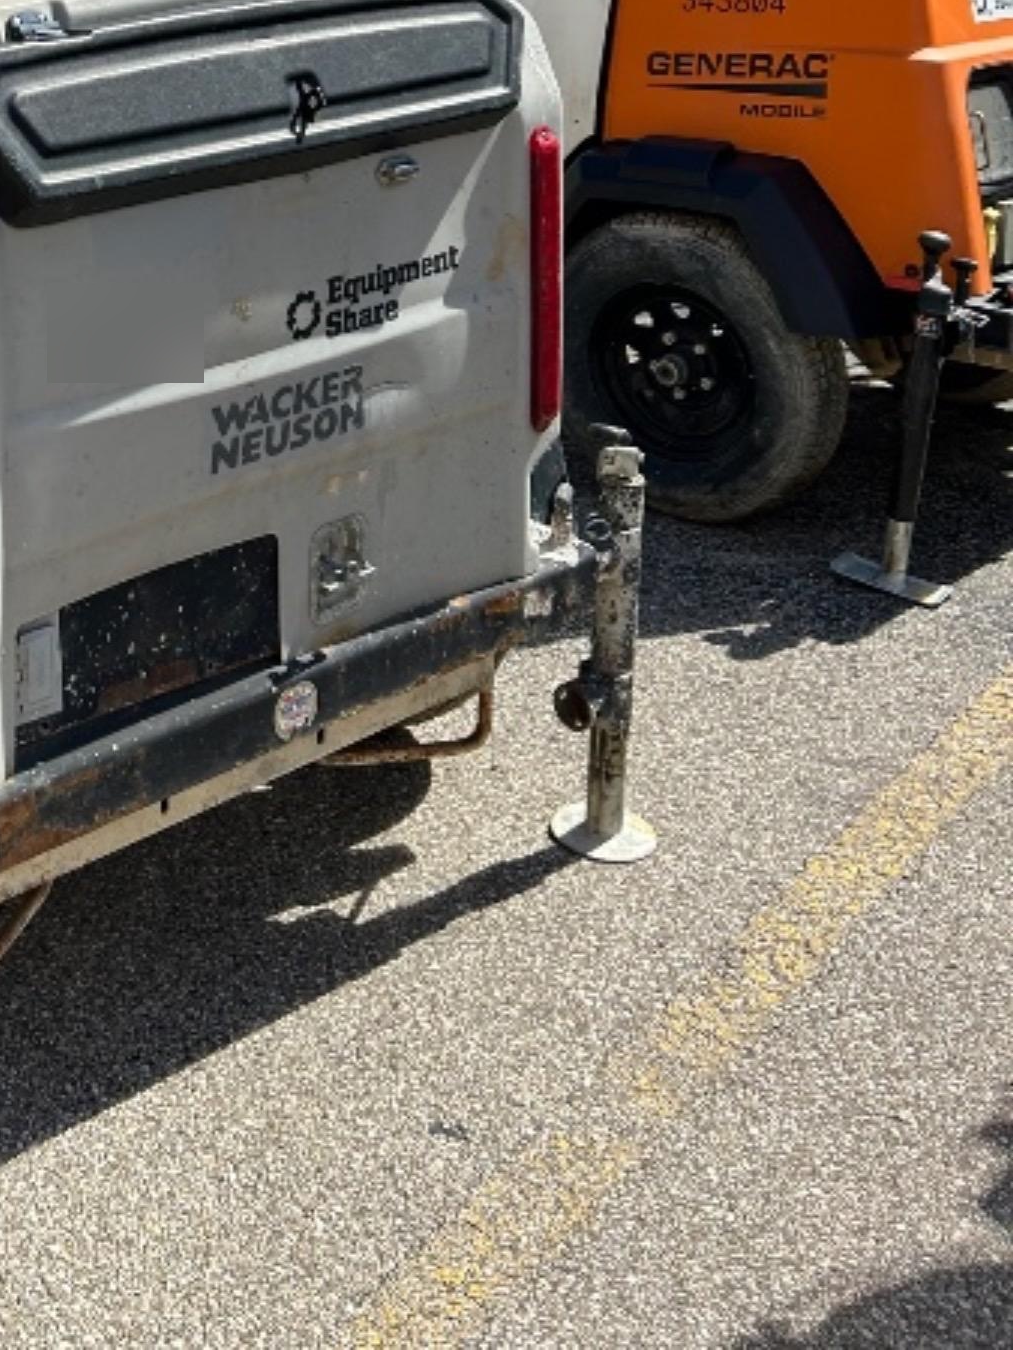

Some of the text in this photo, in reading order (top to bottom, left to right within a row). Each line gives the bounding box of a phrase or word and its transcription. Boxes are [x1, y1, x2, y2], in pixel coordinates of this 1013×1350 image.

[647, 52, 829, 78] GENERAC
[740, 105, 826, 118] MOBILE
[327, 245, 459, 303] Equipment
[325, 299, 398, 338] Share
[211, 365, 363, 437] WACKER
[210, 401, 364, 475] NEUSON
